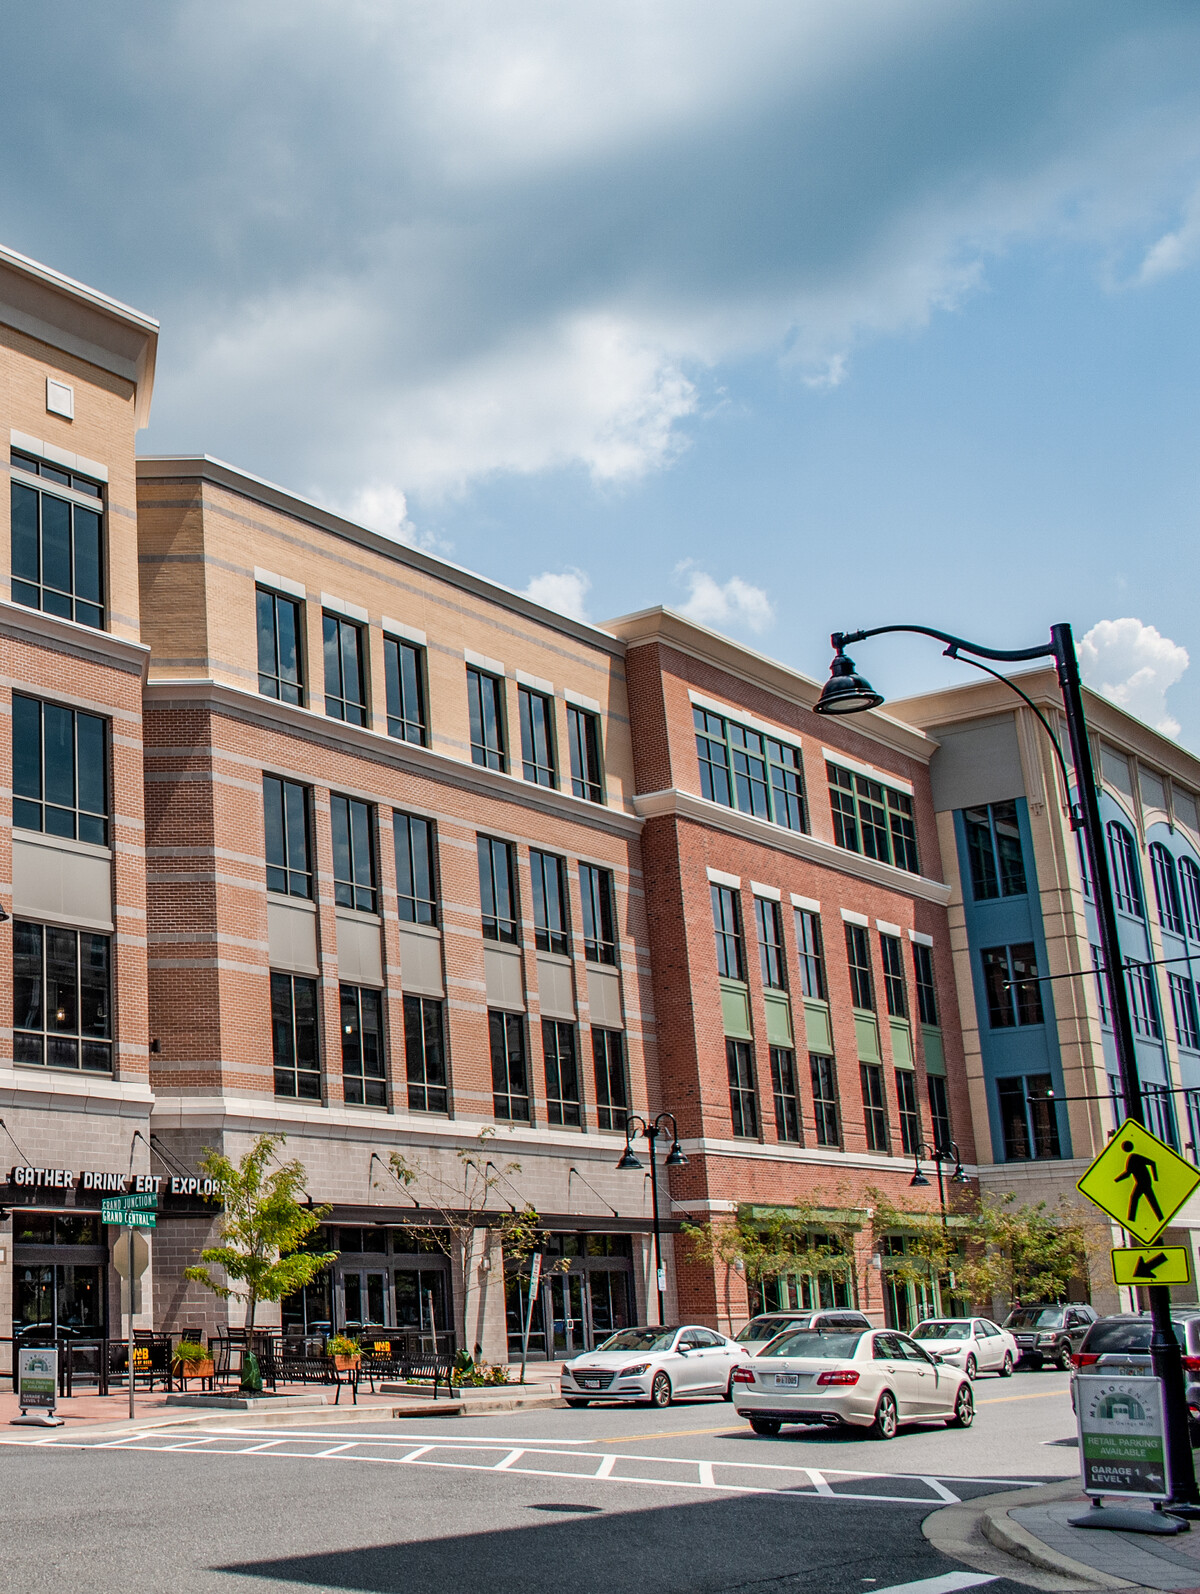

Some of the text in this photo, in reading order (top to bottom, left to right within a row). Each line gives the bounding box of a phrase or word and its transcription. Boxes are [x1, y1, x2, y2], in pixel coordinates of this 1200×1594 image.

[14, 1166, 74, 1189] GATHER
[83, 1171, 127, 1192] DRINK
[135, 1175, 162, 1193] EAT
[102, 1199, 122, 1210] GRAND
[124, 1194, 152, 1209] JUNCTION
[102, 1210, 123, 1223] GRAND
[124, 1212, 150, 1226] CENTRAL
[1087, 1436, 1159, 1449] RETAIL PARKING
[1100, 1447, 1147, 1457] AVAILABLE
[1091, 1465, 1140, 1476] GARAGE 1
[1091, 1474, 1131, 1484] LEVEL 1
